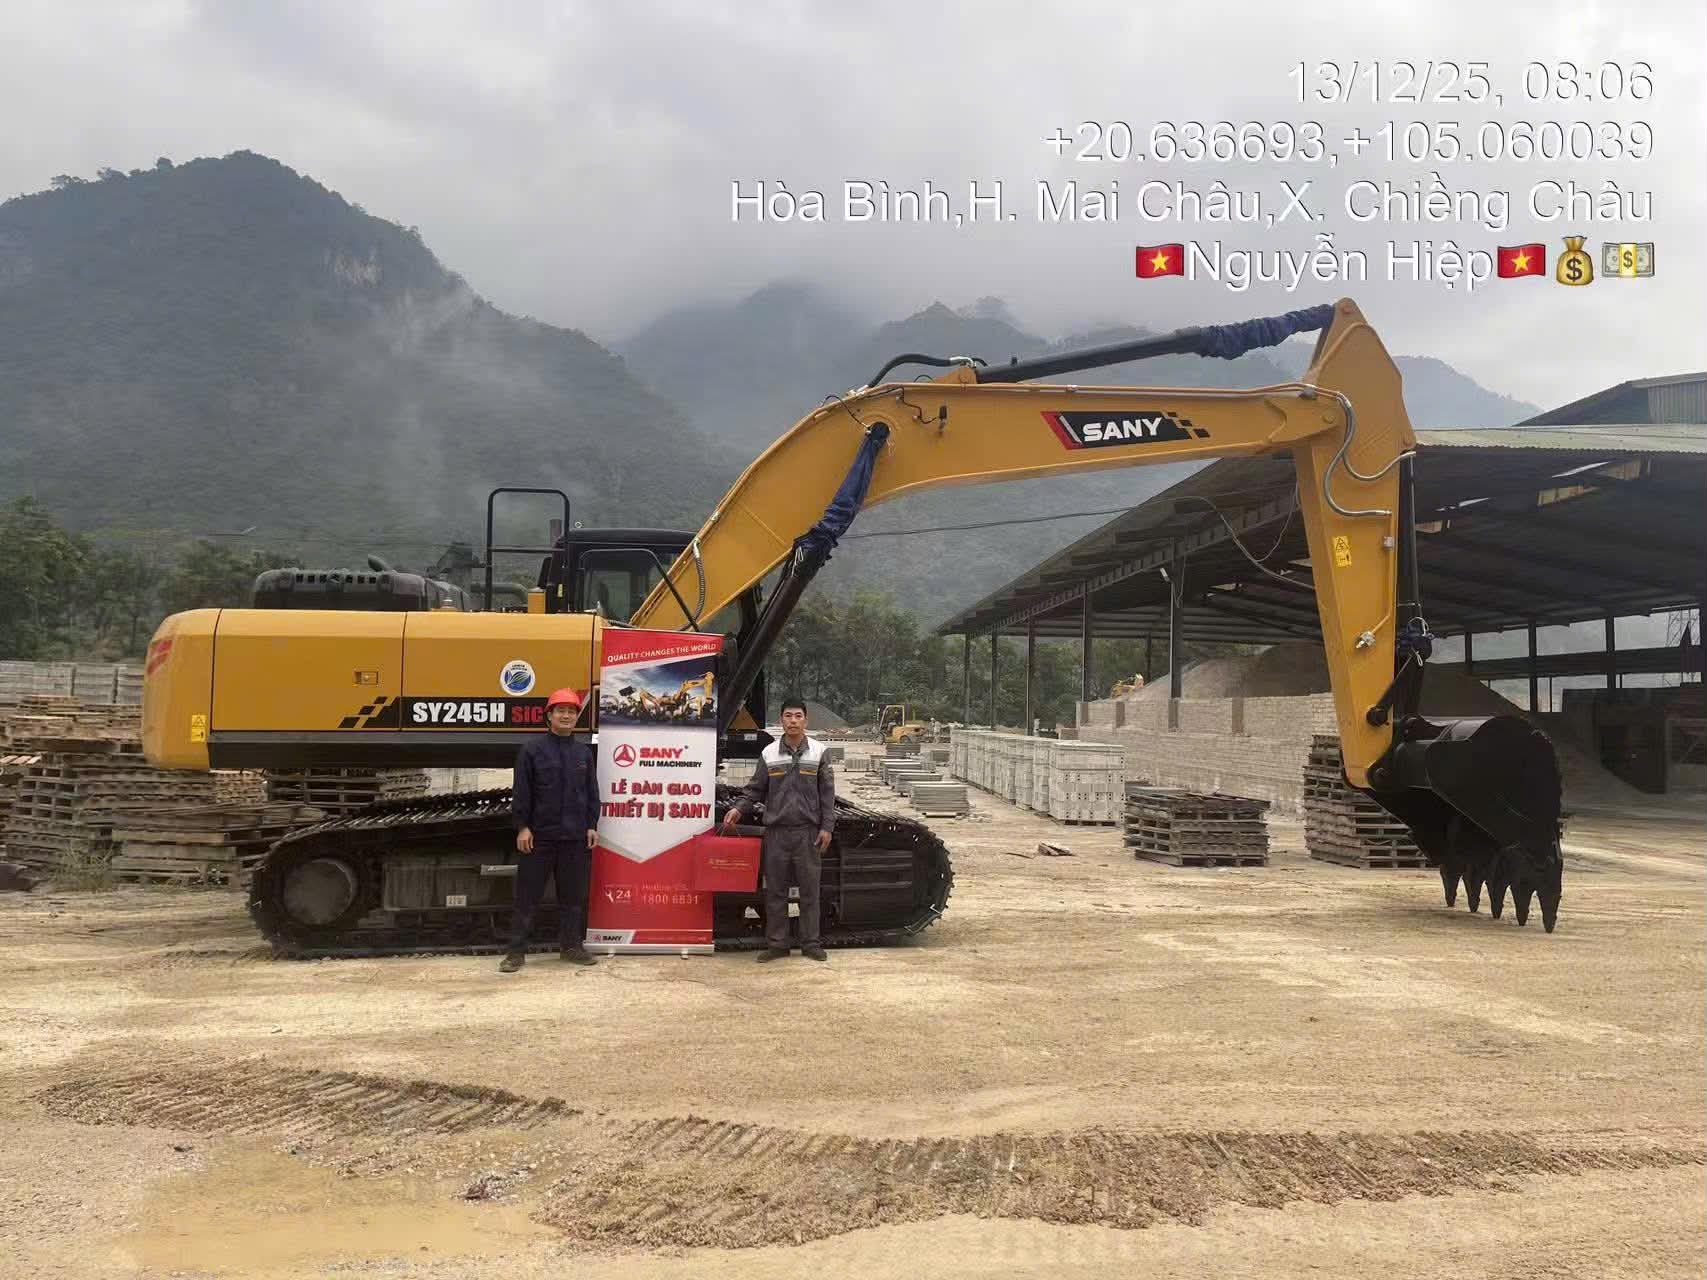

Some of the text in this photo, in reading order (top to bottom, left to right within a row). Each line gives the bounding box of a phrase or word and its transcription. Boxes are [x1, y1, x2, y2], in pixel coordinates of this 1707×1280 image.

[1082, 417, 1162, 442] SANY
[607, 653, 639, 663] QUALITY
[640, 648, 675, 658] CHANGES
[690, 643, 717, 652] WORLD
[412, 702, 505, 723] SY245H
[639, 747, 683, 759] SANY
[656, 760, 702, 768] MACHINERY
[631, 780, 663, 796] BÀN
[667, 782, 702, 796] GIAO
[600, 797, 644, 818] THIẾT
[669, 802, 712, 819] SANY
[616, 890, 632, 900] 24
[643, 894, 669, 905] 1800
